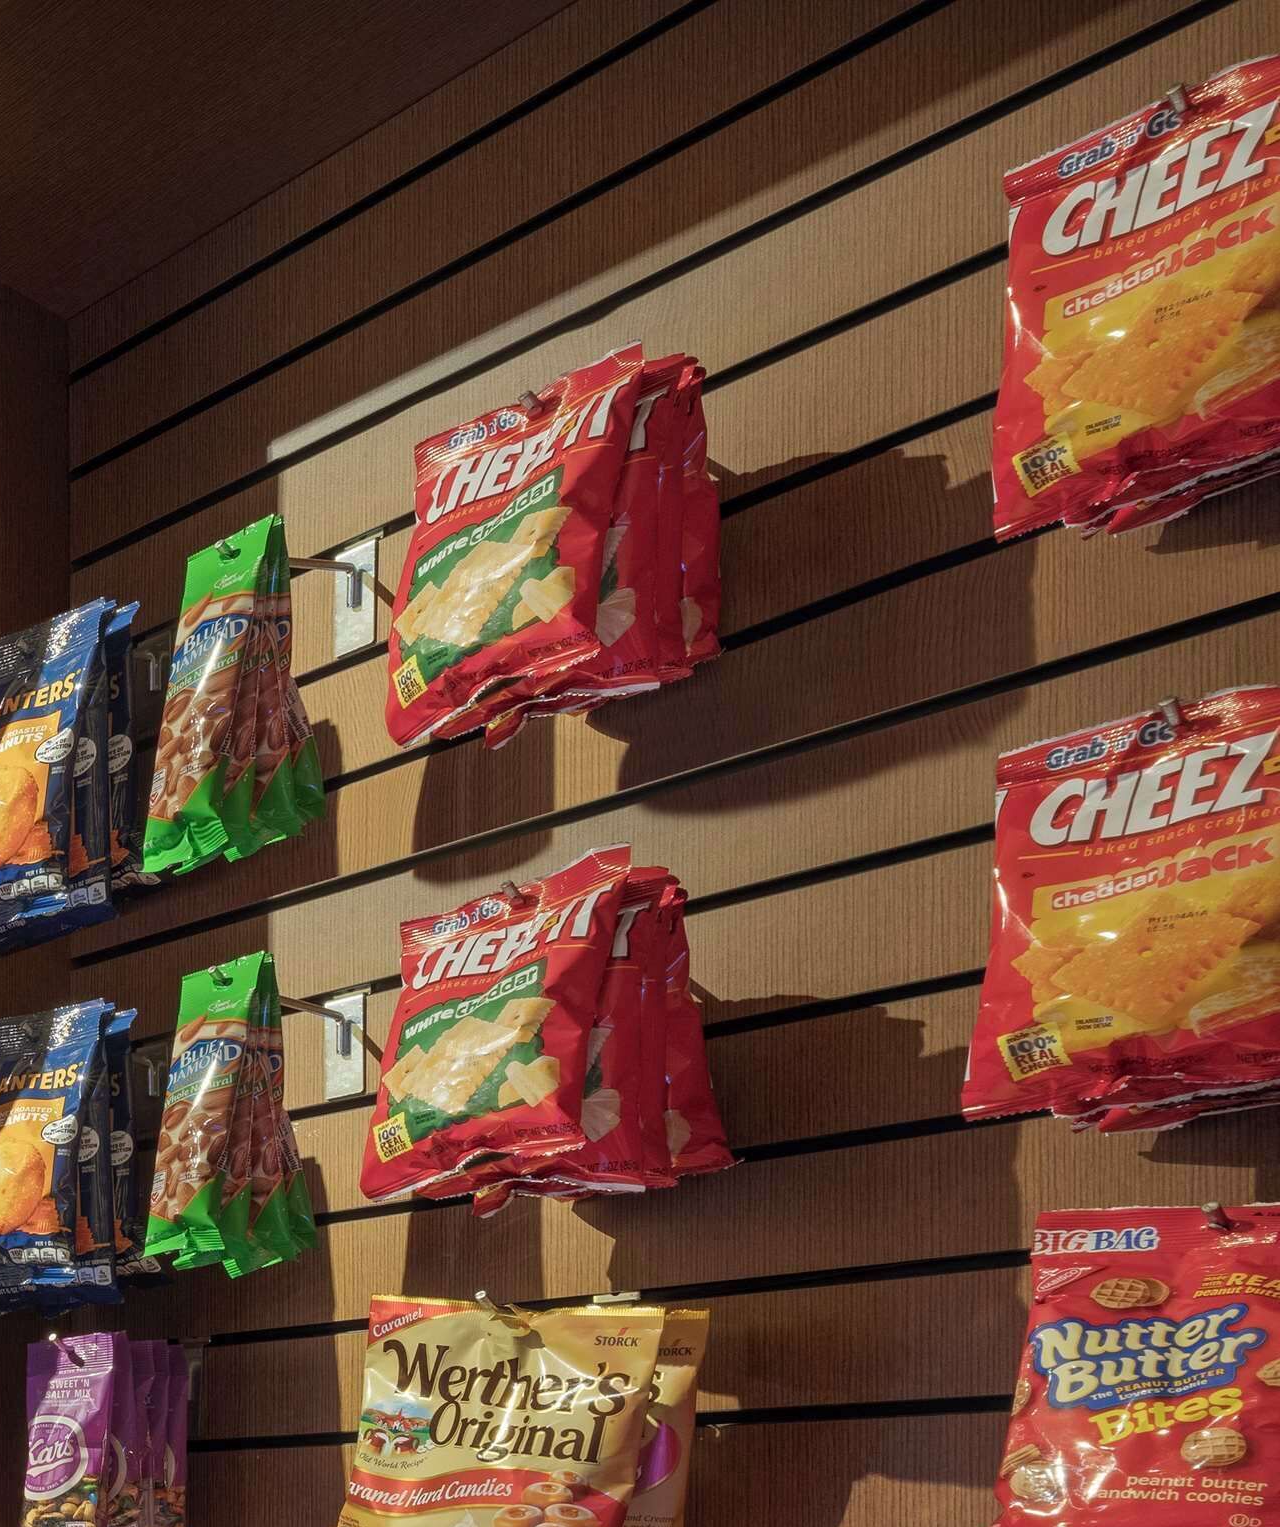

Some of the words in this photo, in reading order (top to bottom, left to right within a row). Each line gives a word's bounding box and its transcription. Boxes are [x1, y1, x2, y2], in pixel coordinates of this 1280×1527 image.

[1058, 136, 1118, 179] Grab
[1093, 231, 1147, 260] baked
[1152, 208, 1202, 239] snack
[1063, 261, 1167, 318] cheddar
[447, 423, 487, 450] Grab
[497, 411, 519, 430] Go
[1021, 446, 1069, 476] 100%
[1026, 461, 1071, 484] REAL
[1033, 468, 1075, 492] CHEESE
[170, 618, 249, 681] DIAMOND
[183, 616, 225, 656] BLUE
[396, 667, 417, 685] 100%
[401, 680, 420, 698] REAL
[1045, 736, 1108, 769] Grab
[1083, 837, 1140, 858] baked
[1146, 824, 1197, 848] snack
[1051, 869, 1159, 909] cheddar
[432, 910, 469, 936] Grab
[479, 899, 502, 919] Go
[180, 1039, 219, 1069] BLUE
[1007, 1035, 1059, 1057] 100%
[1014, 1049, 1060, 1068] REAL
[167, 1043, 243, 1091] DIAMOND
[1020, 1059, 1064, 1076] CHEESE
[377, 1125, 403, 1143] 100%
[379, 1137, 406, 1153] REAL
[382, 1143, 408, 1160] CHEESE
[1032, 1230, 1089, 1254] BIG
[1090, 1227, 1161, 1251] BAG
[1193, 1285, 1245, 1299] peanut
[371, 1307, 425, 1339] Caramel
[1038, 1307, 1242, 1369] Nutter
[593, 1334, 641, 1348] STORCK
[382, 1339, 633, 1418] Werther's
[1052, 1332, 1259, 1404] Butter
[44, 1389, 71, 1399] SALTY
[74, 1388, 91, 1399] MIX
[49, 1379, 78, 1390] SWEET
[1090, 1389, 1114, 1402] The
[1114, 1379, 1169, 1395] PEANUT
[1174, 1367, 1226, 1386] BUTTER
[1118, 1385, 1166, 1402] Lovers'
[1167, 1378, 1209, 1394] Cookie
[1087, 1386, 1245, 1446] Bites
[429, 1399, 602, 1465] Original
[28, 1433, 75, 1466] Kar's
[372, 1457, 400, 1470] World
[399, 1458, 425, 1471] Recipe
[404, 1483, 447, 1509] Hard
[444, 1476, 515, 1501] Candies
[1125, 1474, 1196, 1488] peanut
[1200, 1477, 1270, 1493] butter
[1184, 1489, 1266, 1507] cookies
[643, 1514, 673, 1523] Cream
